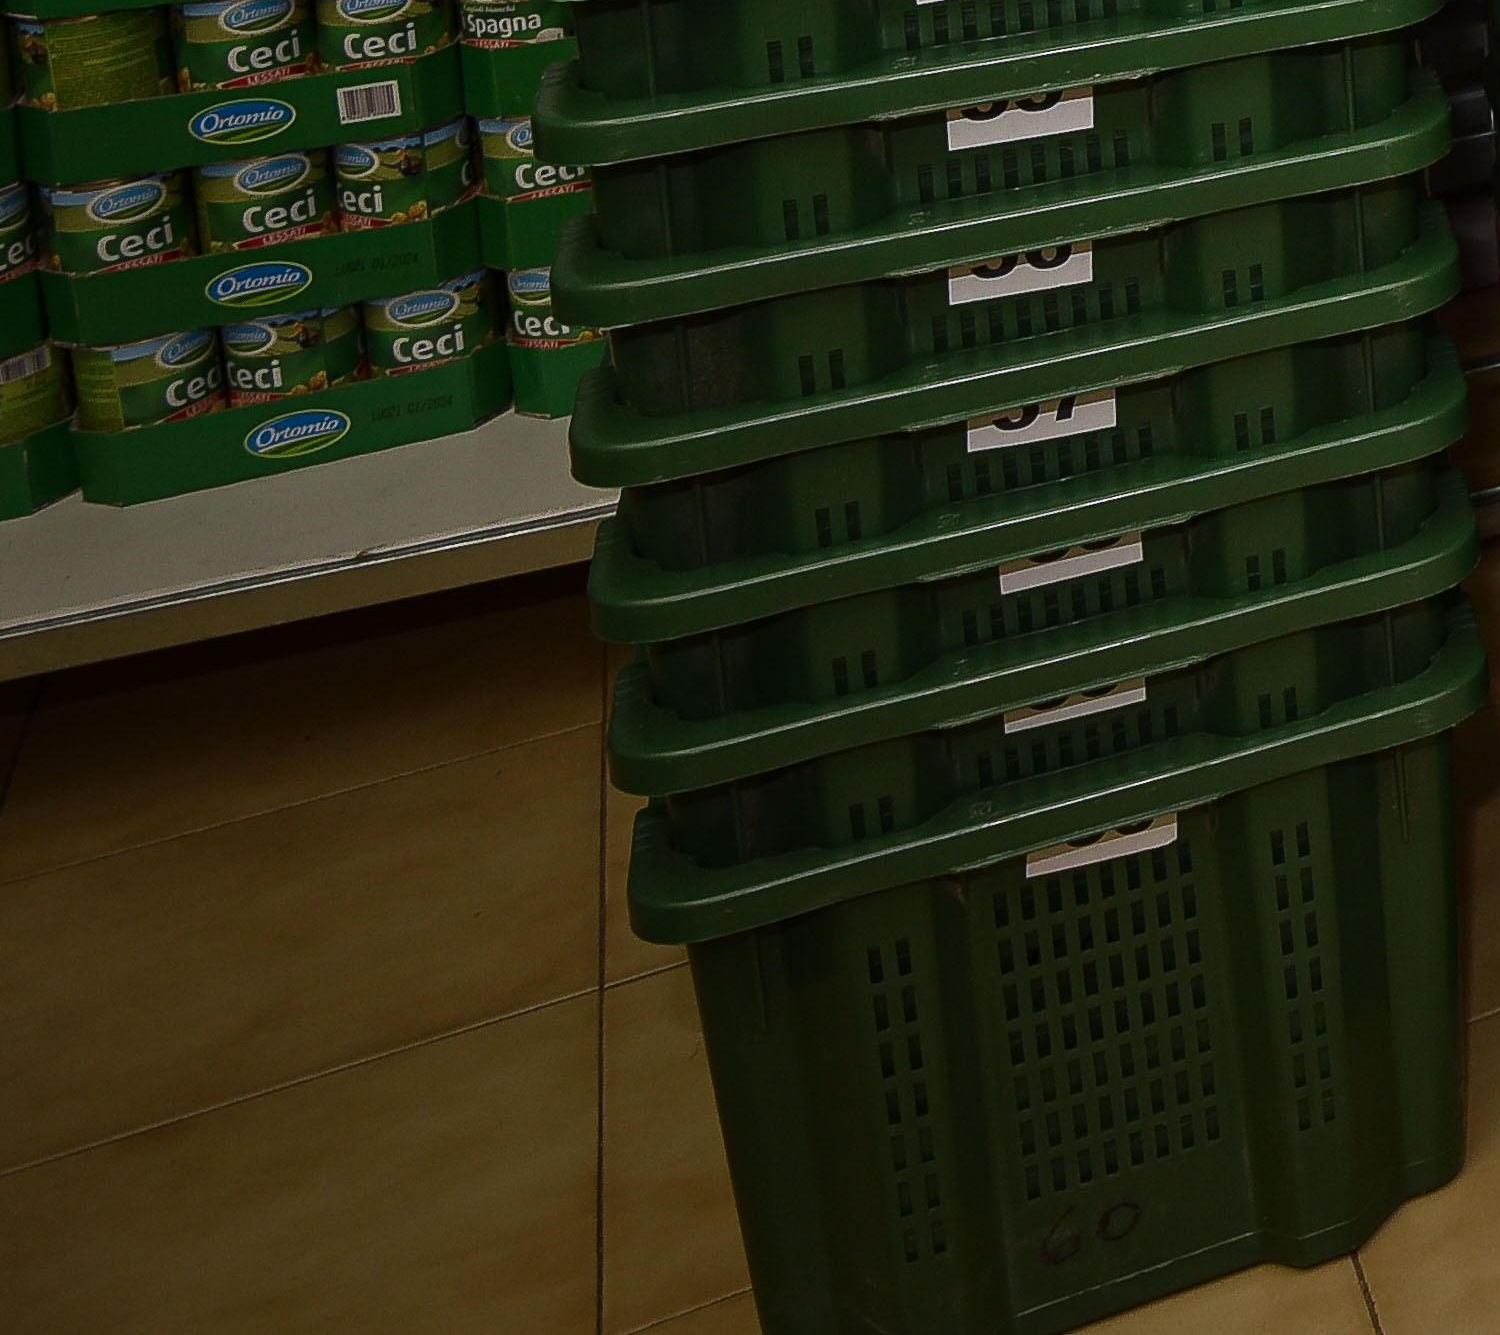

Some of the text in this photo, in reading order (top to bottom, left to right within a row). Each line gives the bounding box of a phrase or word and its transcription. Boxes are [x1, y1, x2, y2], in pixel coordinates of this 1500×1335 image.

[343, 22, 417, 61] Ceci
[467, 10, 542, 39] Spagna
[226, 29, 301, 74] Ceci
[199, 106, 285, 133] Ortomio
[242, 188, 317, 232] Ceci
[95, 215, 174, 263] Ceci
[218, 269, 301, 294] Ortomio
[392, 327, 465, 366] Ceci
[253, 419, 339, 448] Ortomio
